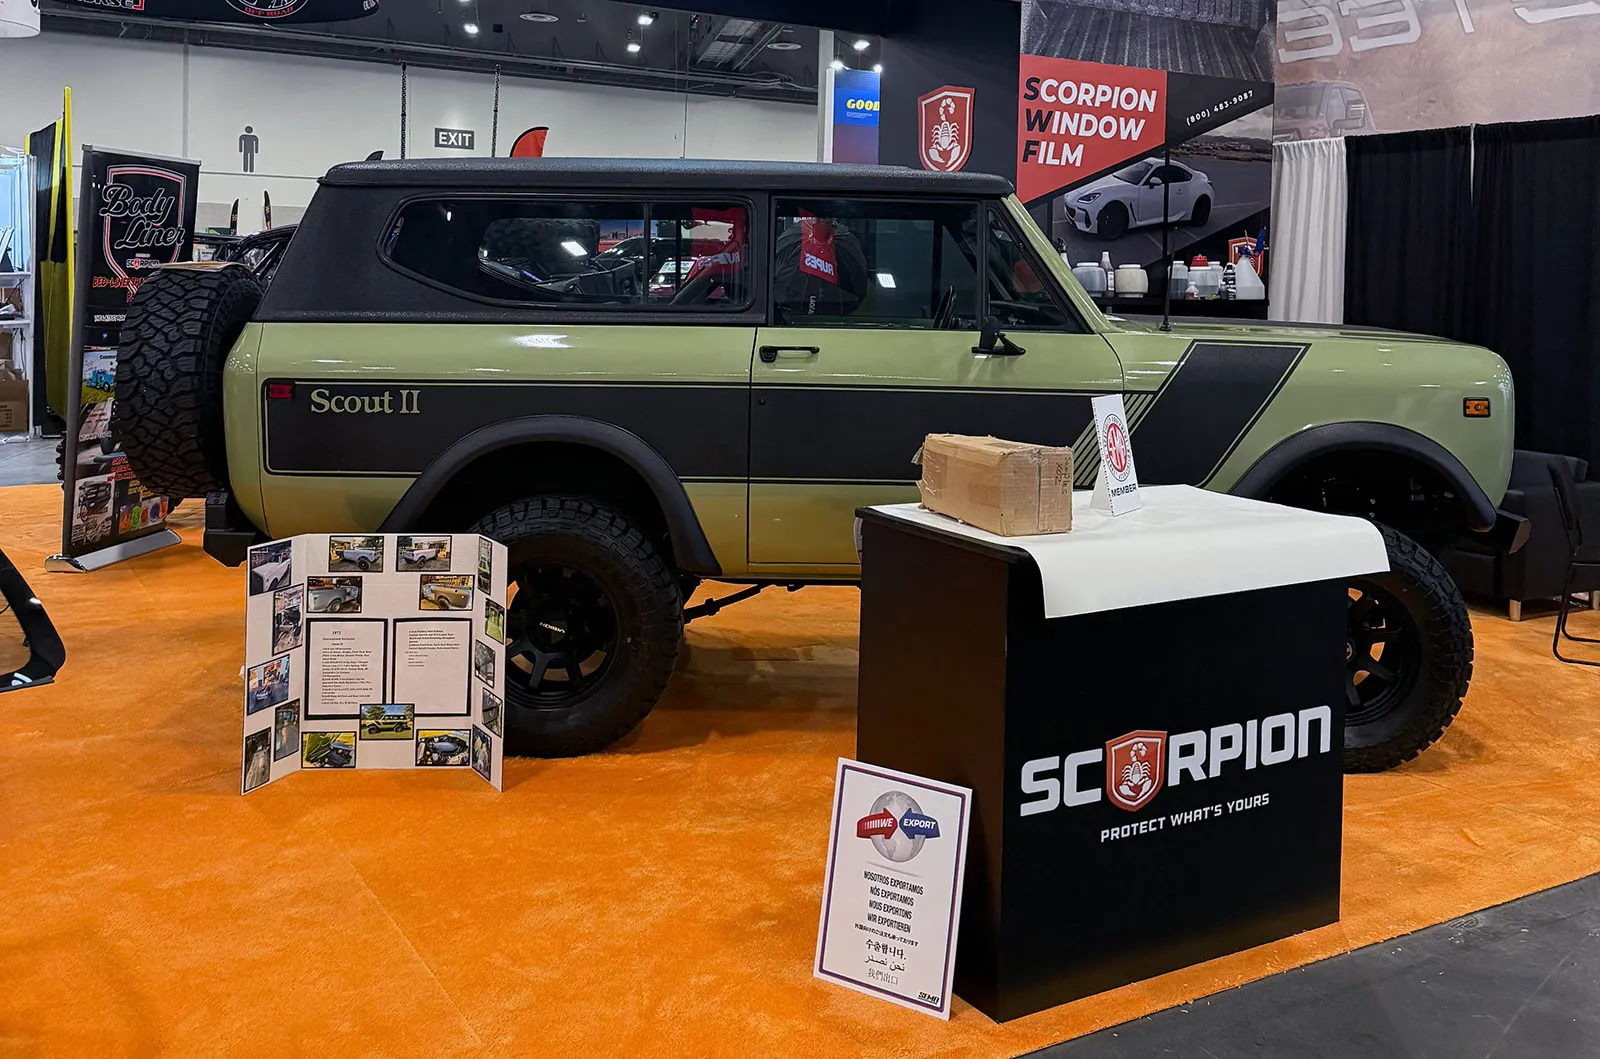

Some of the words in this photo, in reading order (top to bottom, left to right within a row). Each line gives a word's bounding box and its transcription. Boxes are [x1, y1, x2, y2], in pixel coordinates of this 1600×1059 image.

[1023, 77, 1157, 113] SCORPION
[1025, 108, 1146, 141] WINDOW
[1186, 108, 1211, 126] (800)
[439, 131, 472, 146] EXIT
[1022, 140, 1084, 167] FILM
[99, 183, 175, 227] Body
[114, 215, 185, 249] Liner
[311, 388, 394, 414] Scout
[399, 389, 421, 414] II
[1061, 456, 1072, 495] Samples
[1111, 483, 1137, 497] MEMBER
[1020, 705, 1331, 817] SCORPION
[880, 818, 894, 828] WE
[903, 818, 936, 829] EXPORT
[1101, 816, 1166, 843] PROTECT
[1170, 804, 1222, 827] WHAT'S
[1227, 793, 1270, 813] YOURS
[864, 870, 890, 886] NOSOTROS
[889, 878, 924, 896] EXPORTAMOS
[870, 885, 881, 897] NÓS
[880, 889, 914, 907] EXPORTAMOS
[868, 899, 883, 911] NOUS
[882, 903, 913, 920] EXPORTONS
[867, 912, 878, 923] WIR
[877, 915, 912, 934] EXPORTIEREN
[889, 961, 905, 972] نحن
